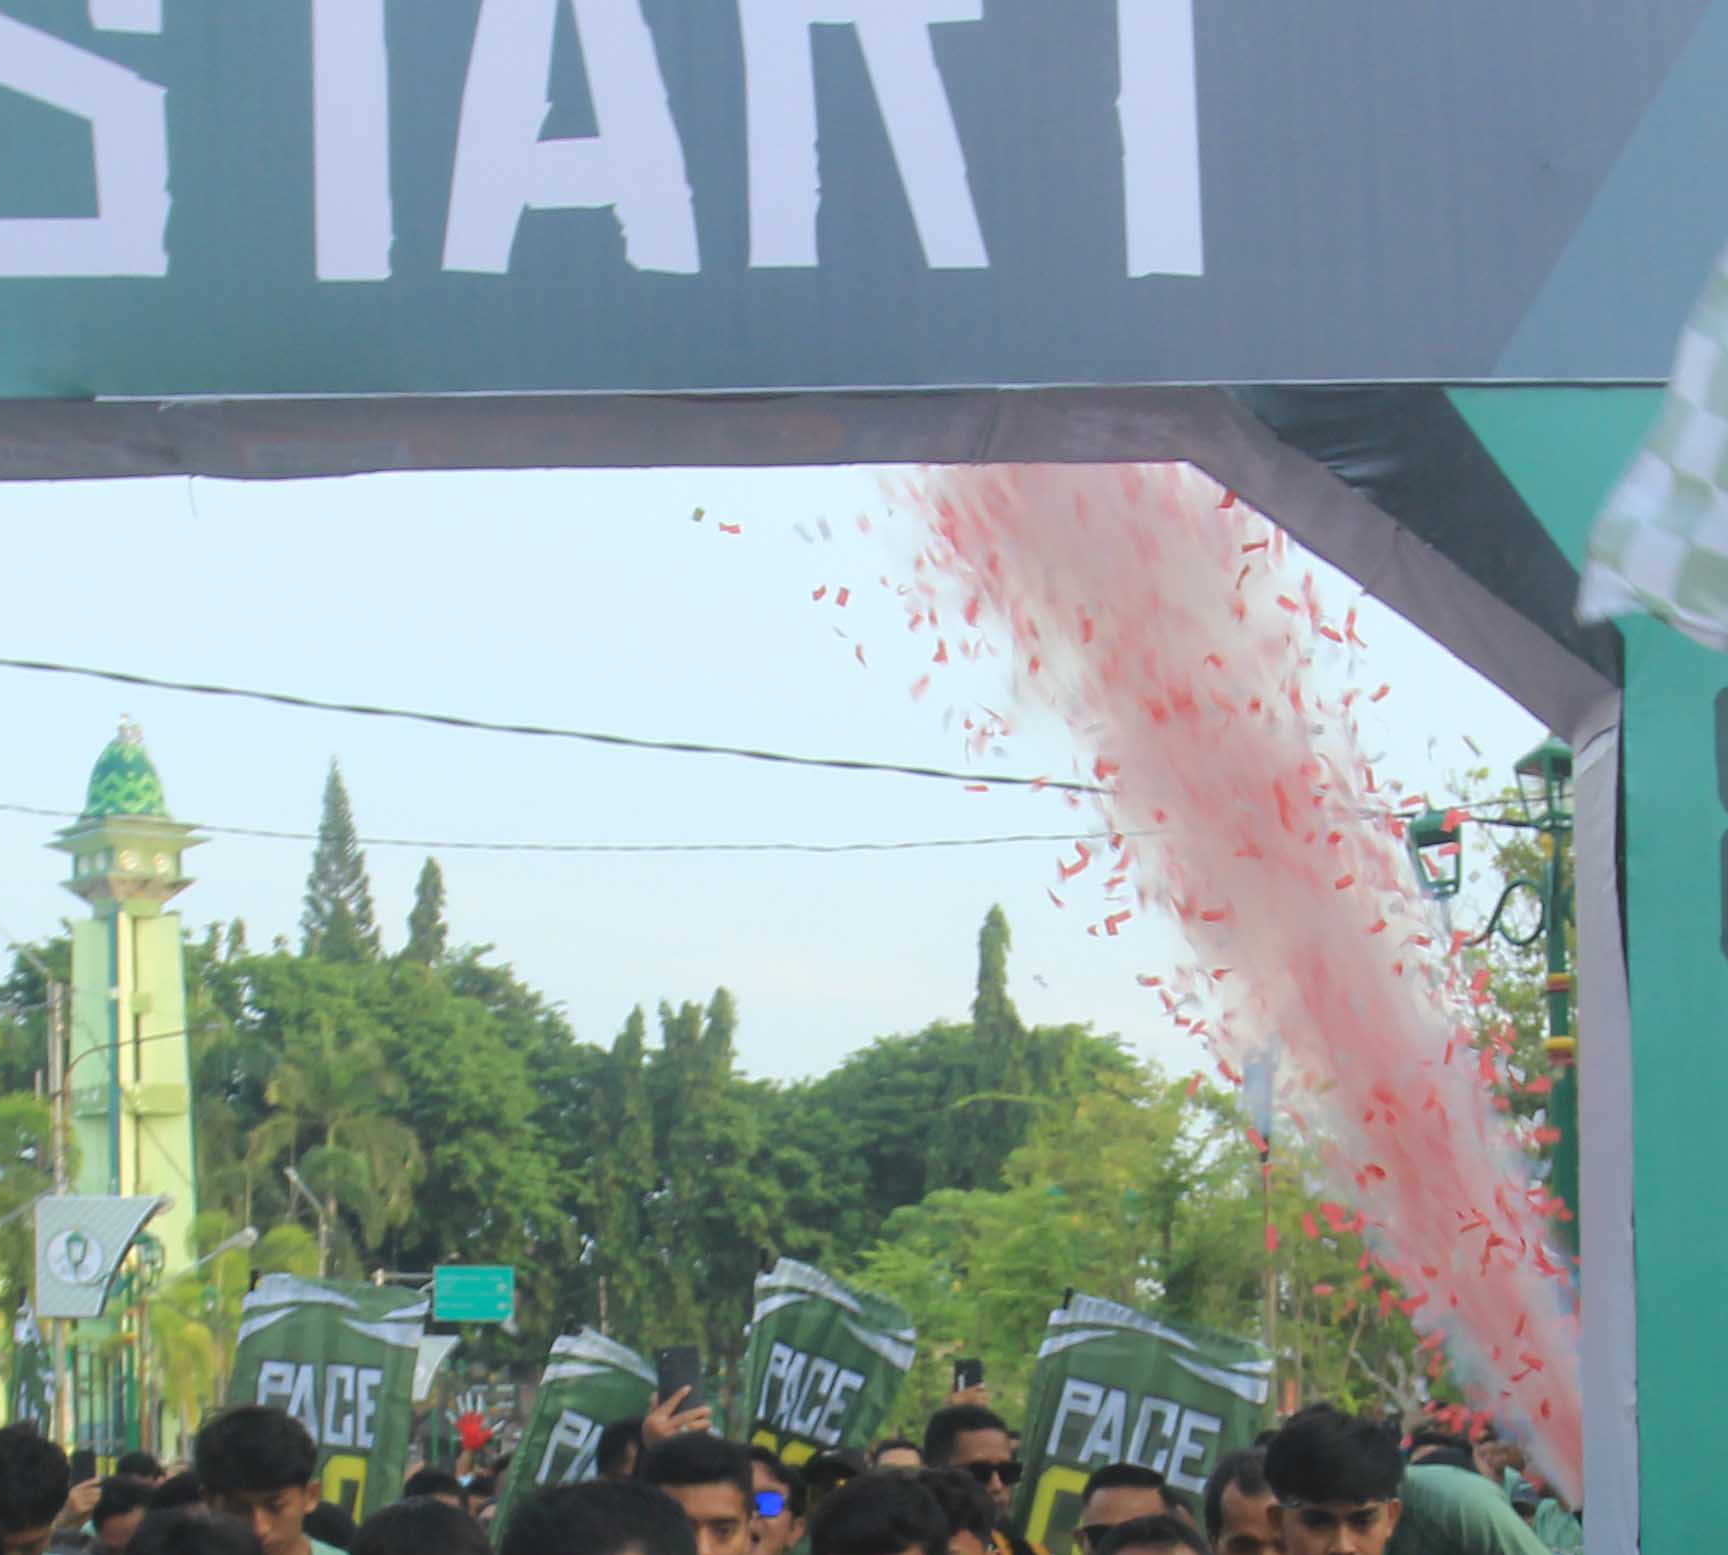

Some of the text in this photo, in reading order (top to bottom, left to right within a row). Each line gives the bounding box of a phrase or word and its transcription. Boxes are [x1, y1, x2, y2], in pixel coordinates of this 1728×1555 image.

[256, 1360, 383, 1448] PACE
[755, 1341, 865, 1446] PACE
[1045, 1377, 1222, 1494] PACE
